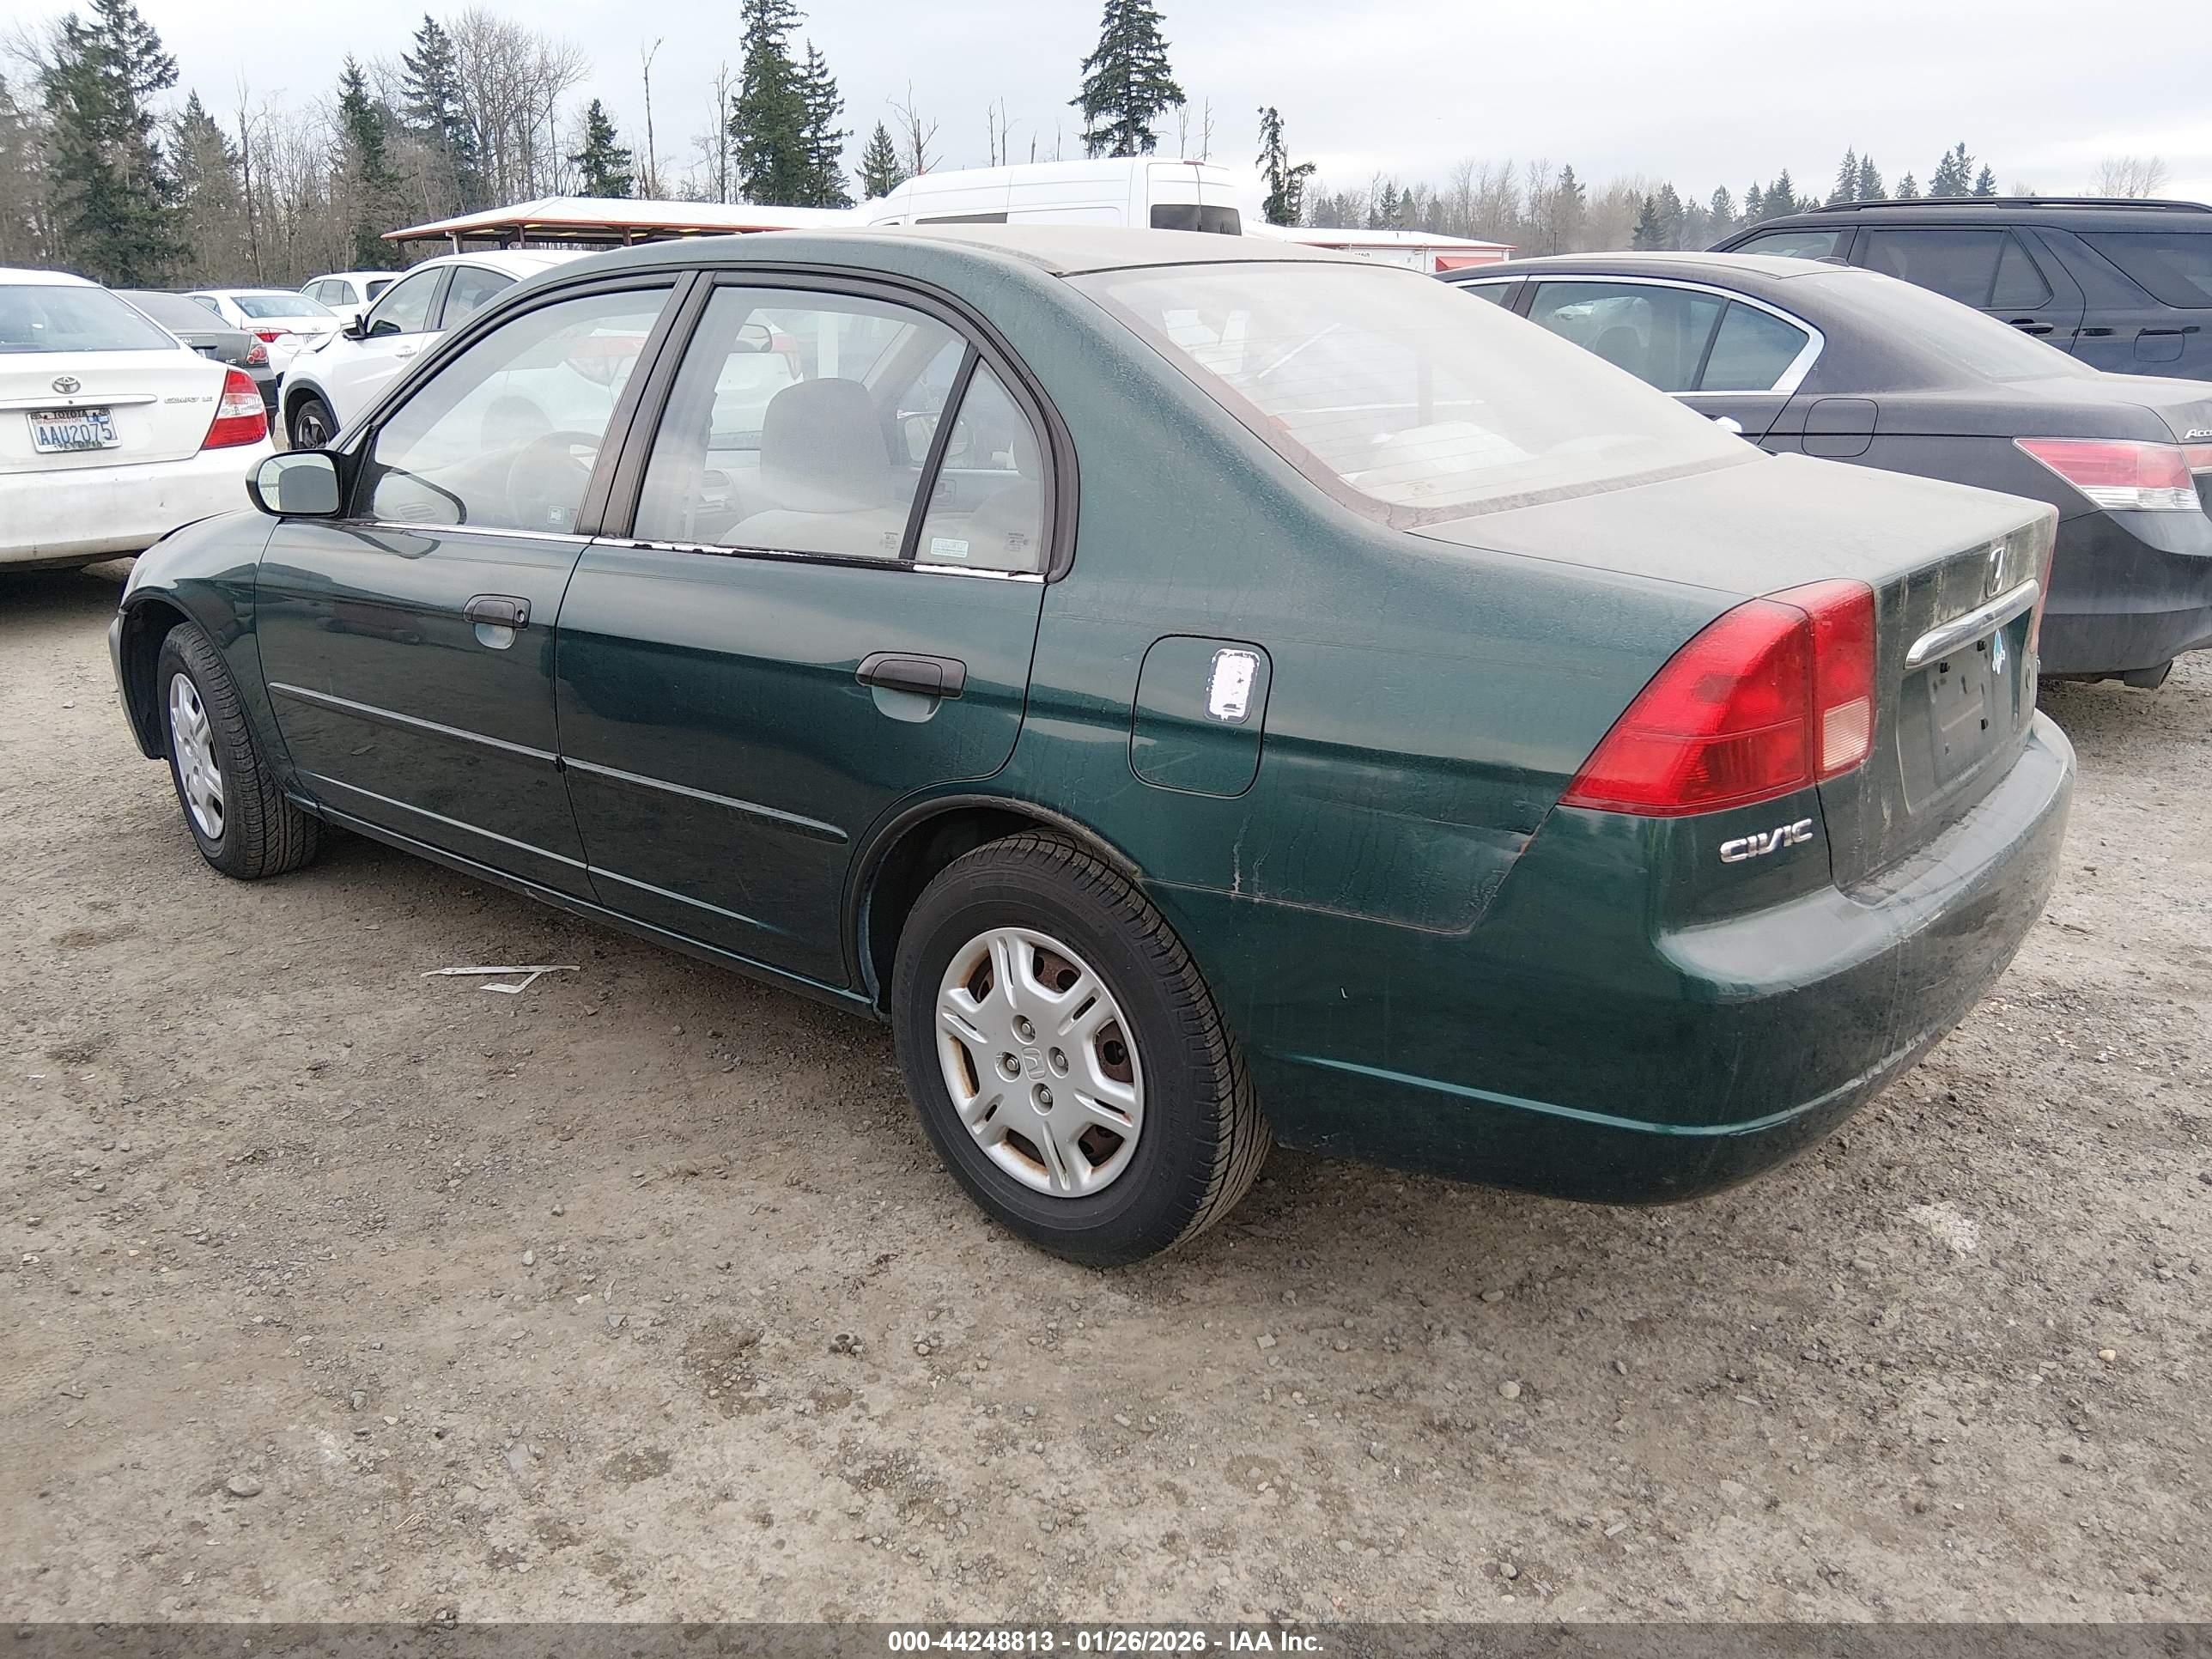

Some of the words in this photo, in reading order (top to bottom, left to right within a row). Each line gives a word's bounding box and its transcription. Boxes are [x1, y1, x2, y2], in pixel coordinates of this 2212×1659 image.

[53, 410, 88, 420] TOYOTA
[40, 422, 112, 446] AAU2075
[1720, 817, 1814, 863] CIVIC
